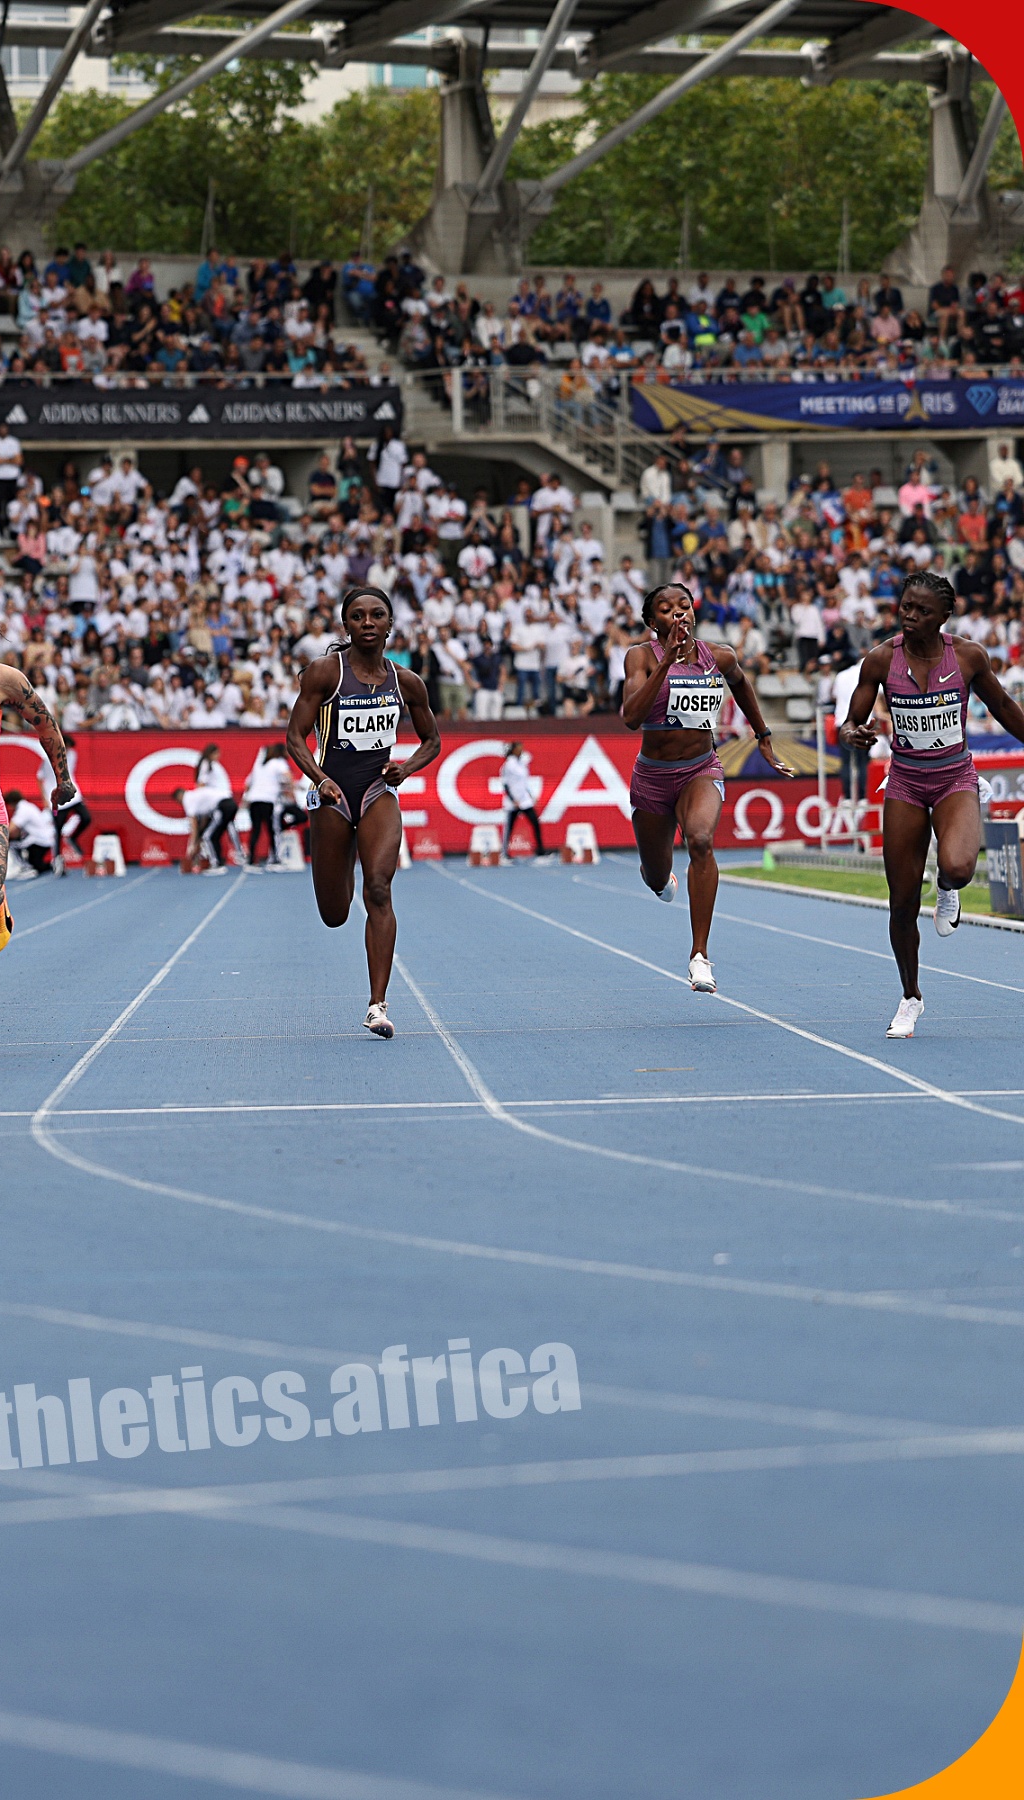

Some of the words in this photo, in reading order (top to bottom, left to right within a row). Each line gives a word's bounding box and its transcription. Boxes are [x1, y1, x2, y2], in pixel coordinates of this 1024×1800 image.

[39, 402, 101, 424] ADIDAS
[102, 402, 181, 424] RUNNERS
[221, 402, 284, 423] ADIDAS
[286, 401, 366, 422] RUNNERS
[799, 395, 877, 414] MEETING
[897, 390, 957, 420] PARIS
[340, 698, 371, 706] MEETING
[377, 694, 396, 706] PARIS
[671, 695, 722, 712] JOSEPH
[891, 696, 924, 705] MEETING
[932, 692, 958, 706] PARIS
[343, 713, 396, 733] CLARK
[895, 713, 919, 732] BASS
[921, 710, 958, 732] BITTAYE
